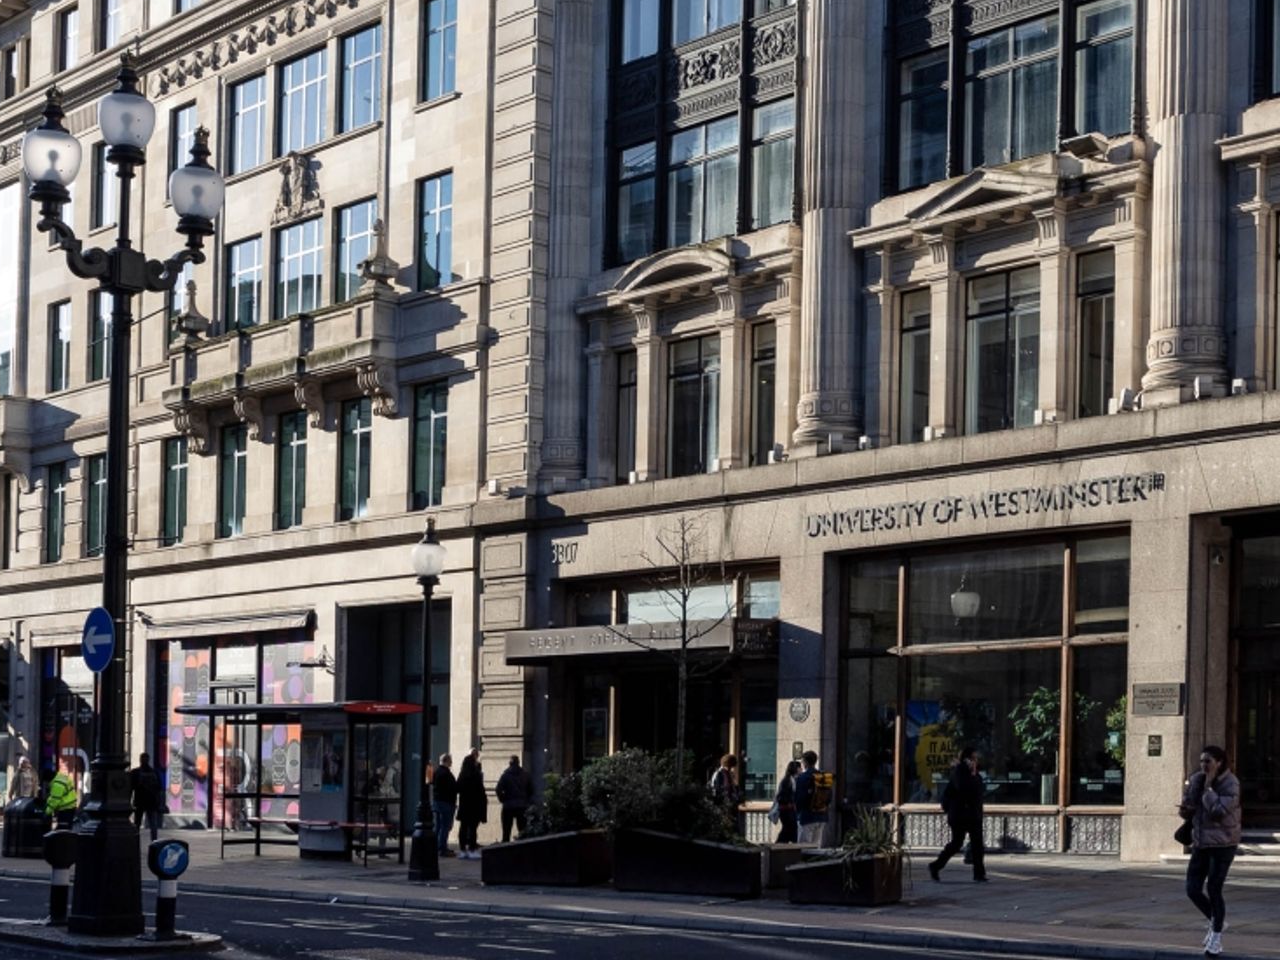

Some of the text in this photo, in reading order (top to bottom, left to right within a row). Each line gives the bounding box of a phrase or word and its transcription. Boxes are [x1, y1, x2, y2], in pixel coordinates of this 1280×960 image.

[806, 477, 1148, 538] UNIVERSITY OF WESTMINSTER
